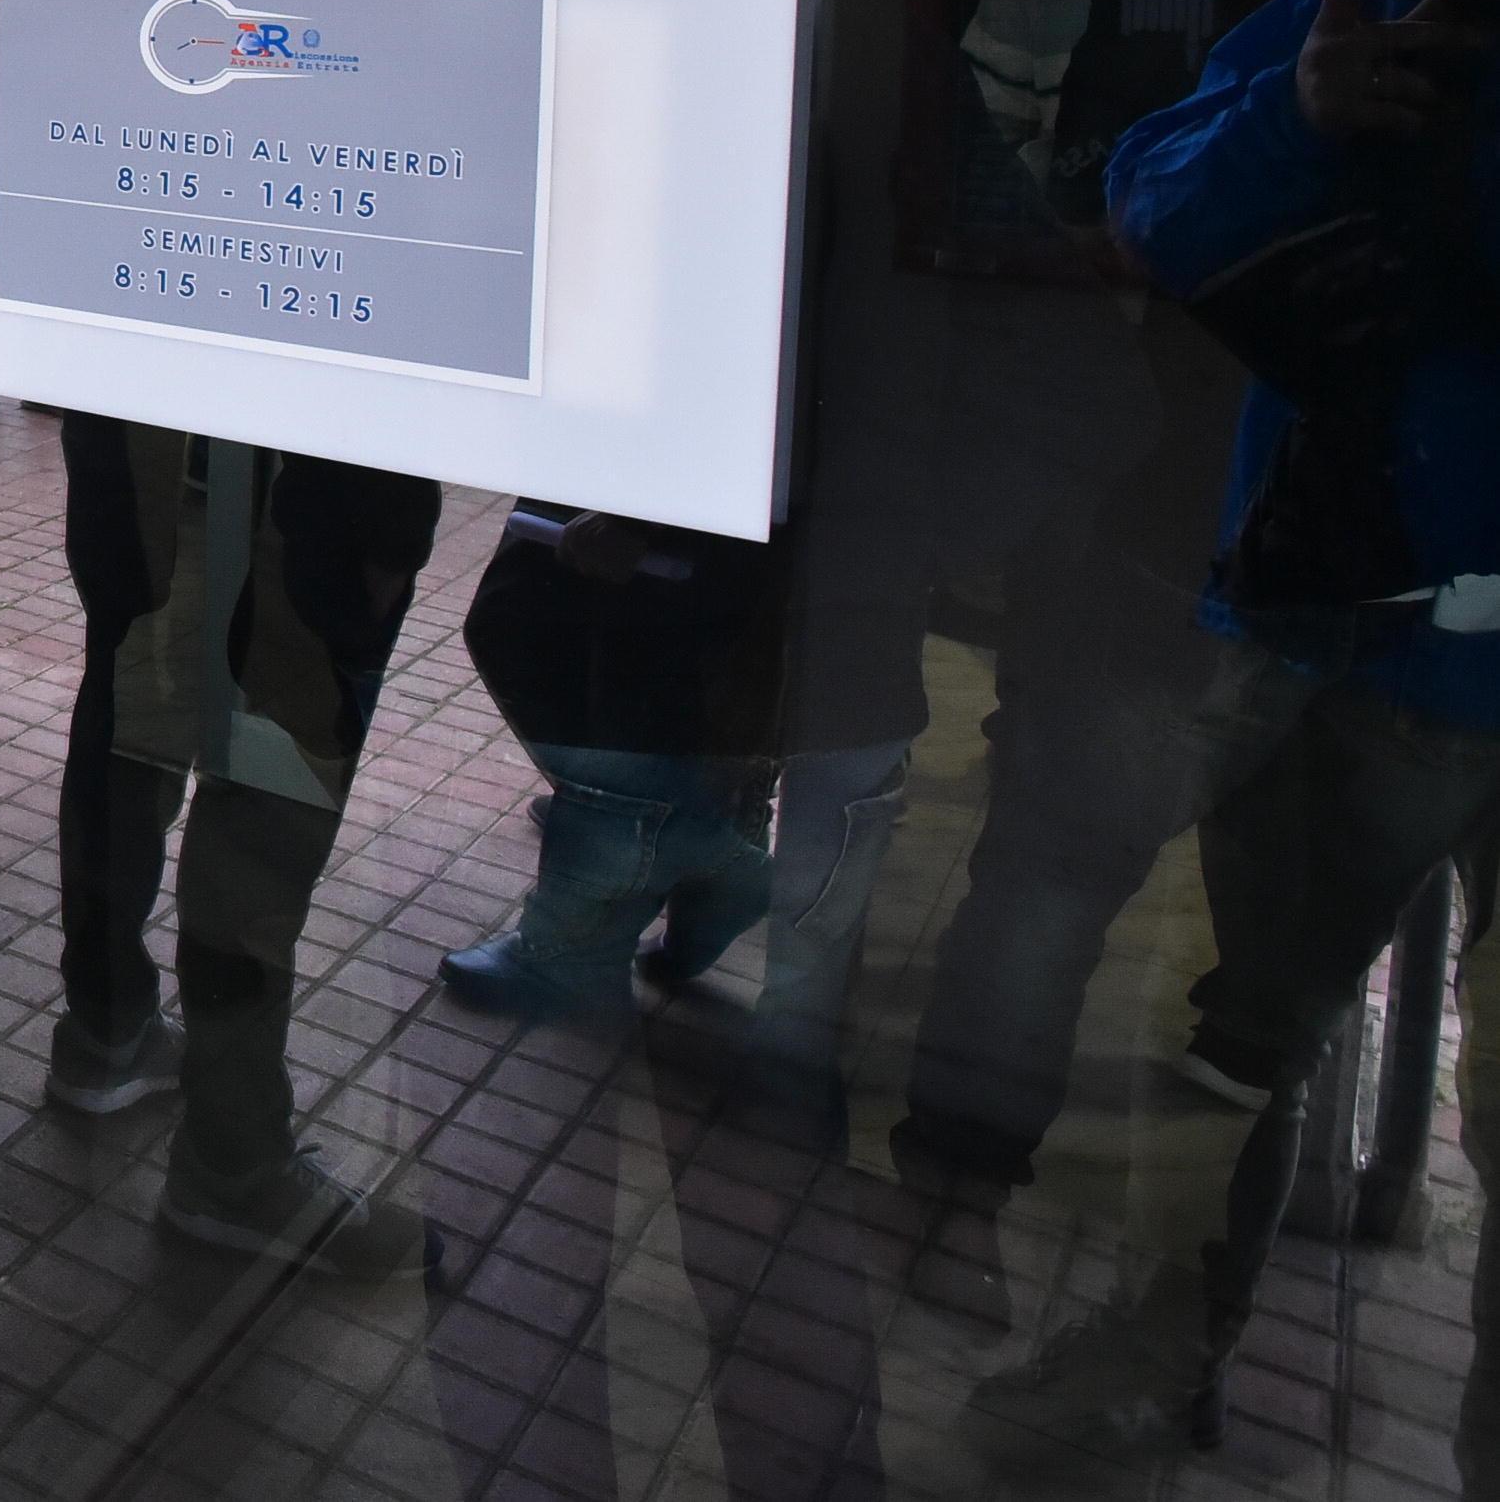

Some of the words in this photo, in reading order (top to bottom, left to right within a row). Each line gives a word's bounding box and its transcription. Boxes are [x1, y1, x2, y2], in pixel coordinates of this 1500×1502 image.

[49, 121, 106, 147] DAL
[121, 126, 234, 159] LUNEDÌ
[250, 138, 291, 164] AL
[307, 143, 464, 180] VENERDÌ
[116, 166, 200, 200] 8:15
[260, 180, 377, 219] 14:15
[142, 227, 344, 274] SEMIFESTIVI
[114, 262, 197, 298] 8:15
[256, 282, 374, 324] 12:15
